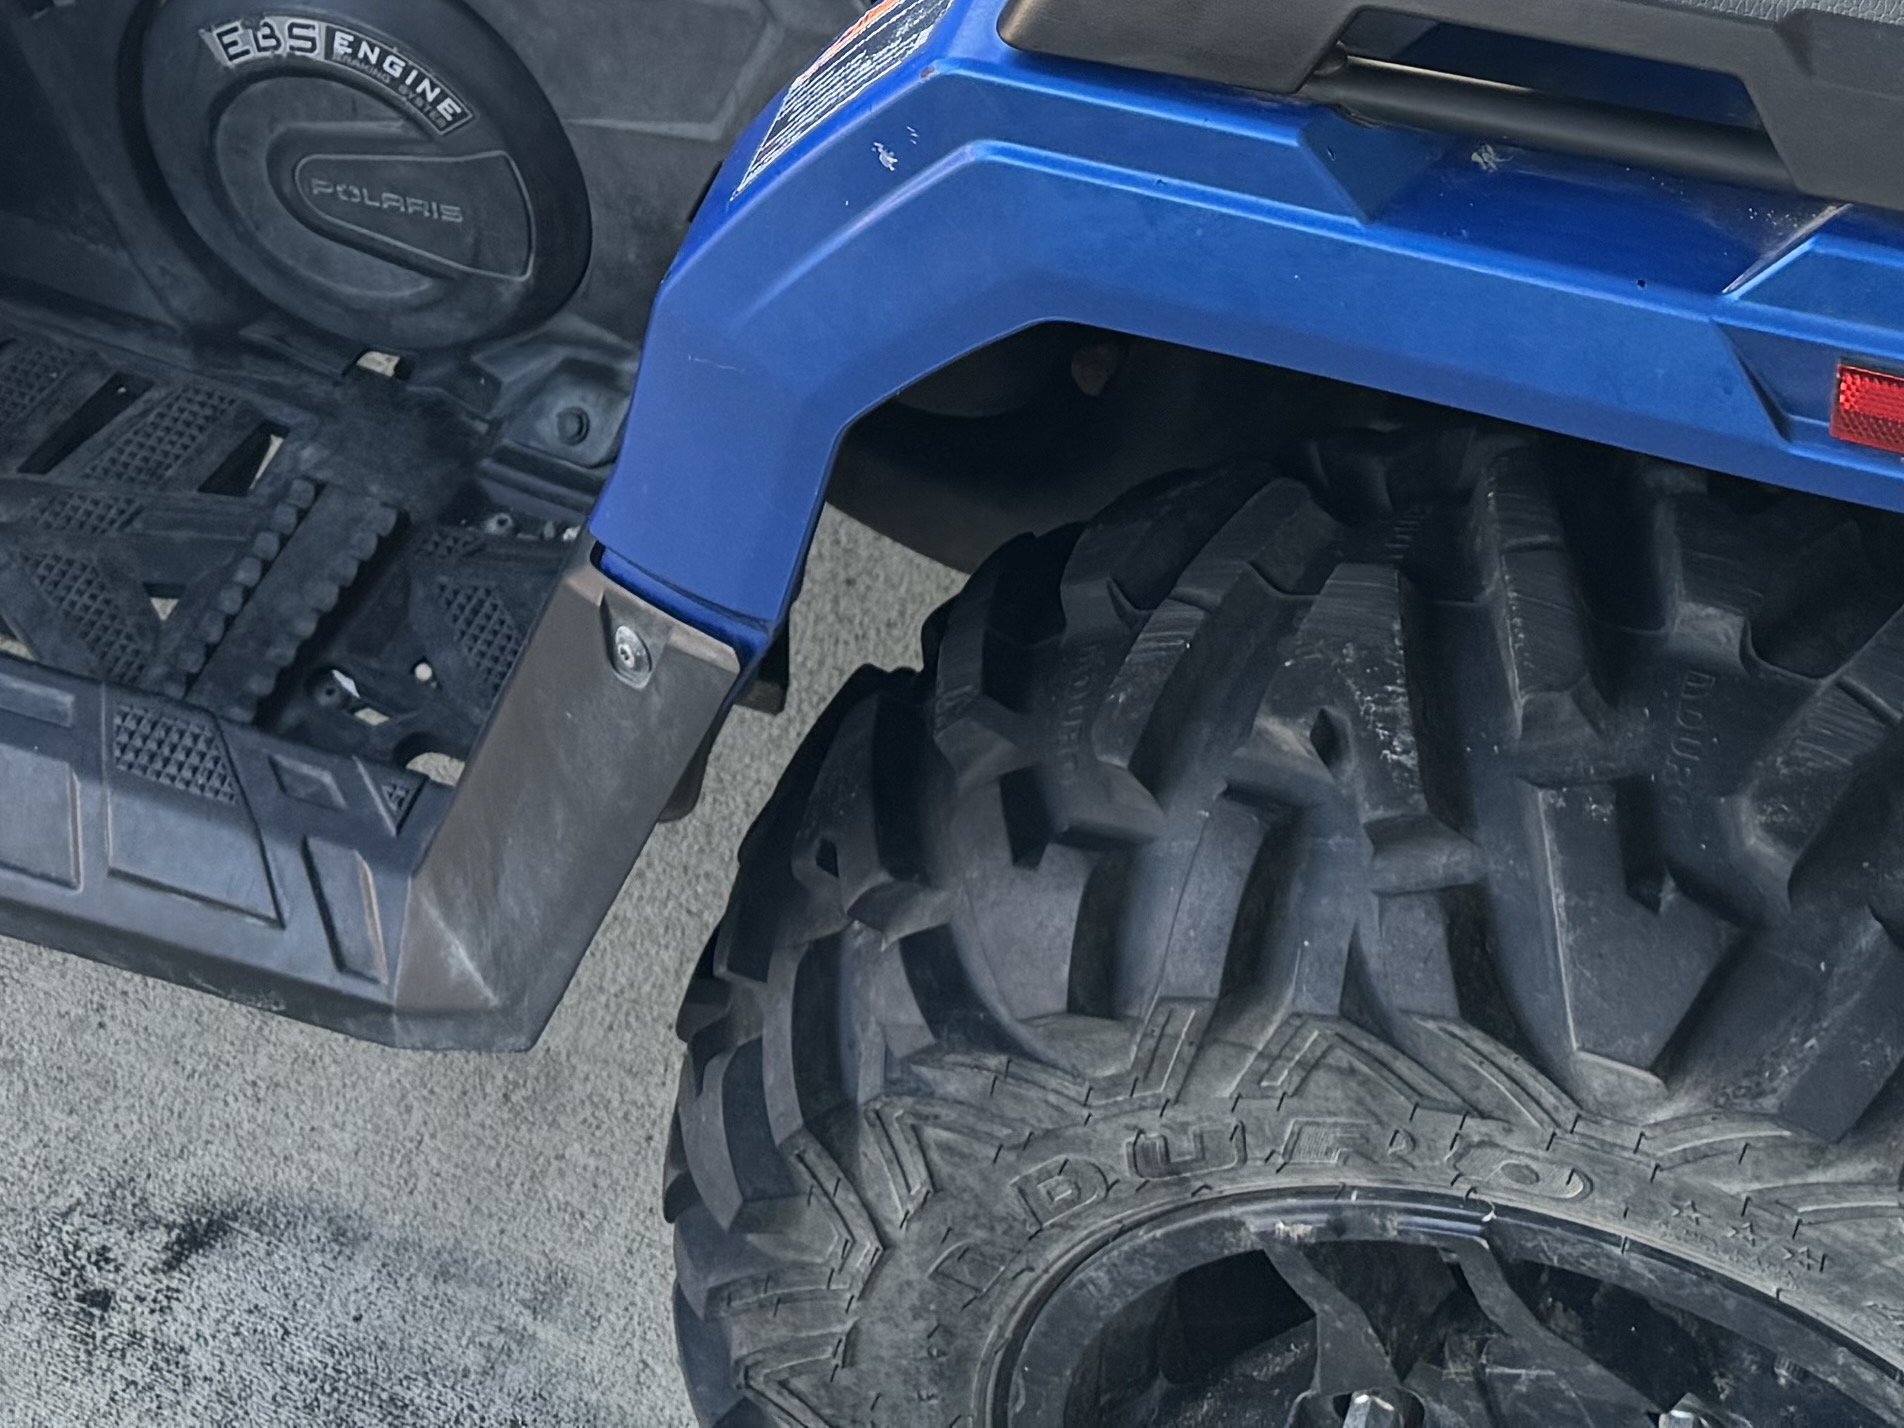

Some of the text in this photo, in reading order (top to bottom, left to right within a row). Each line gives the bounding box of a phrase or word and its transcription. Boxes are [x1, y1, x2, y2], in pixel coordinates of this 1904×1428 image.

[212, 18, 462, 122] EBS ENGINE
[310, 177, 464, 223] POLARIS
